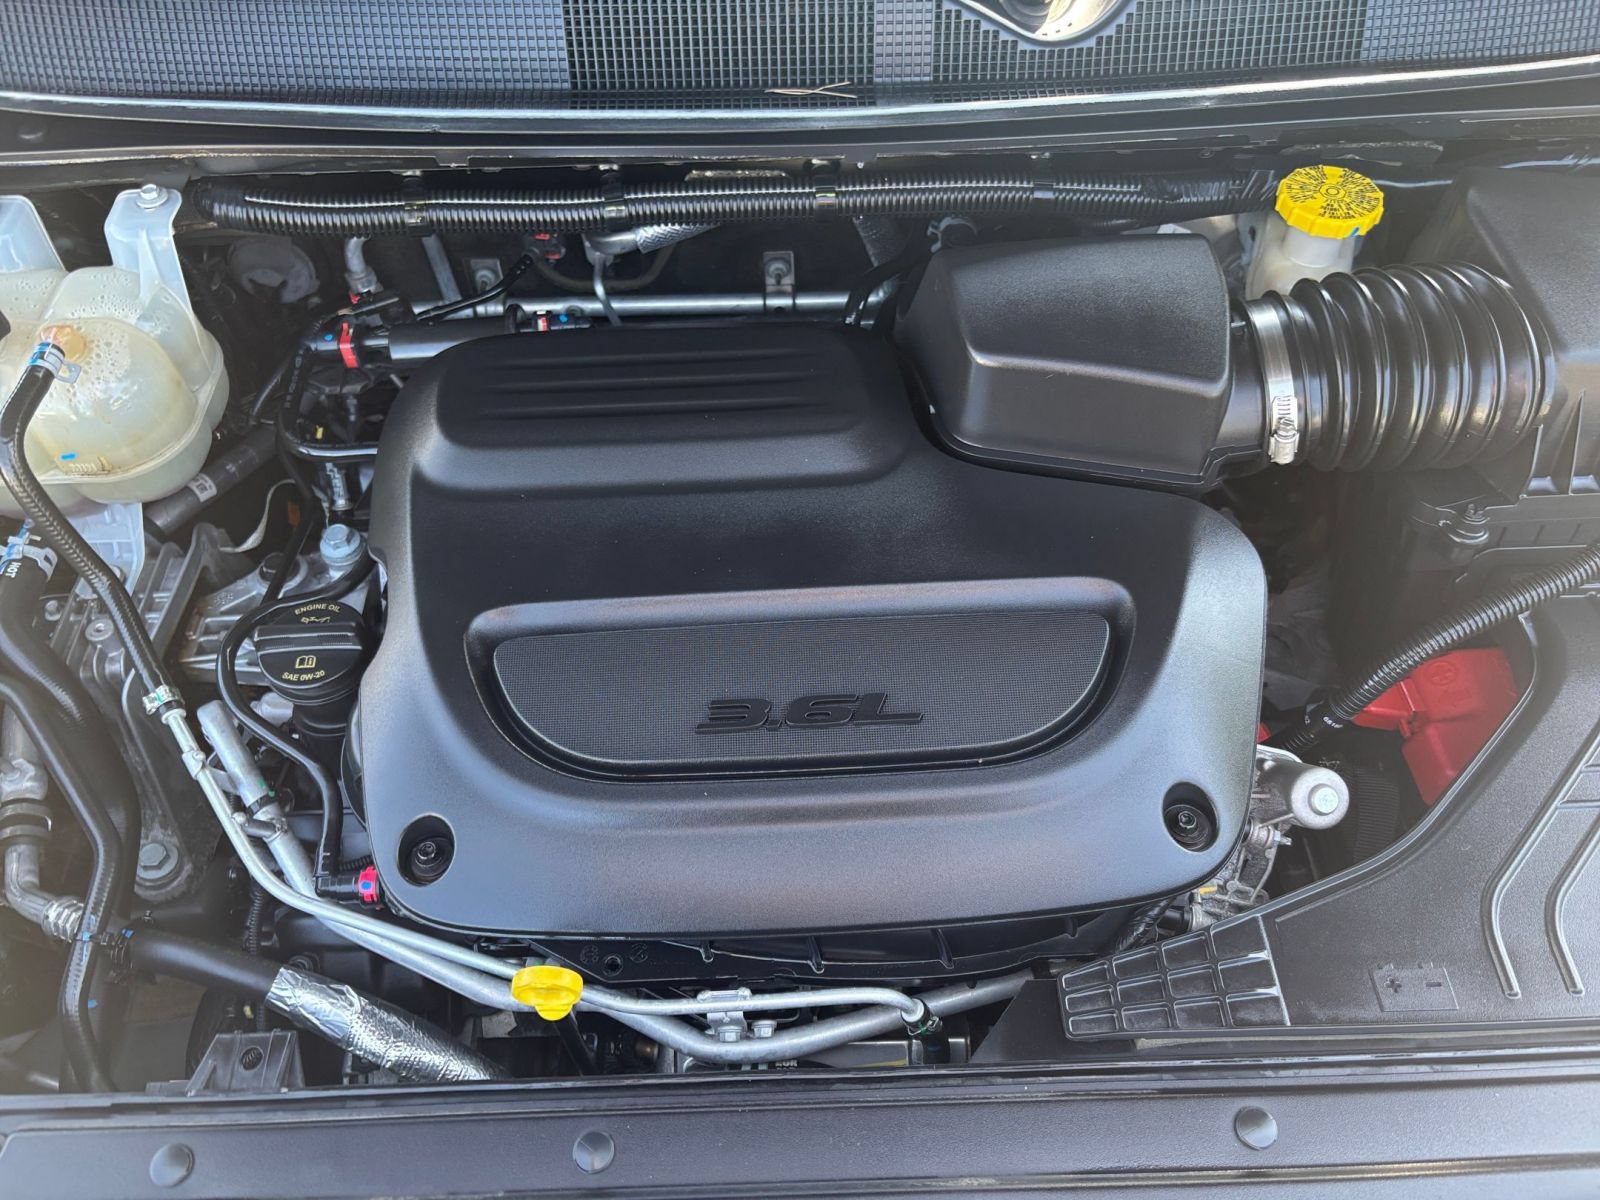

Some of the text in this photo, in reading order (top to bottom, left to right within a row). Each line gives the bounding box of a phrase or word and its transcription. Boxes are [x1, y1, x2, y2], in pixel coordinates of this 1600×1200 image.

[5, 561, 22, 578] HOT
[294, 603, 341, 615] ENGINE OIL
[281, 669, 325, 681] SAE 0W-20
[695, 692, 924, 735] 3.6L
